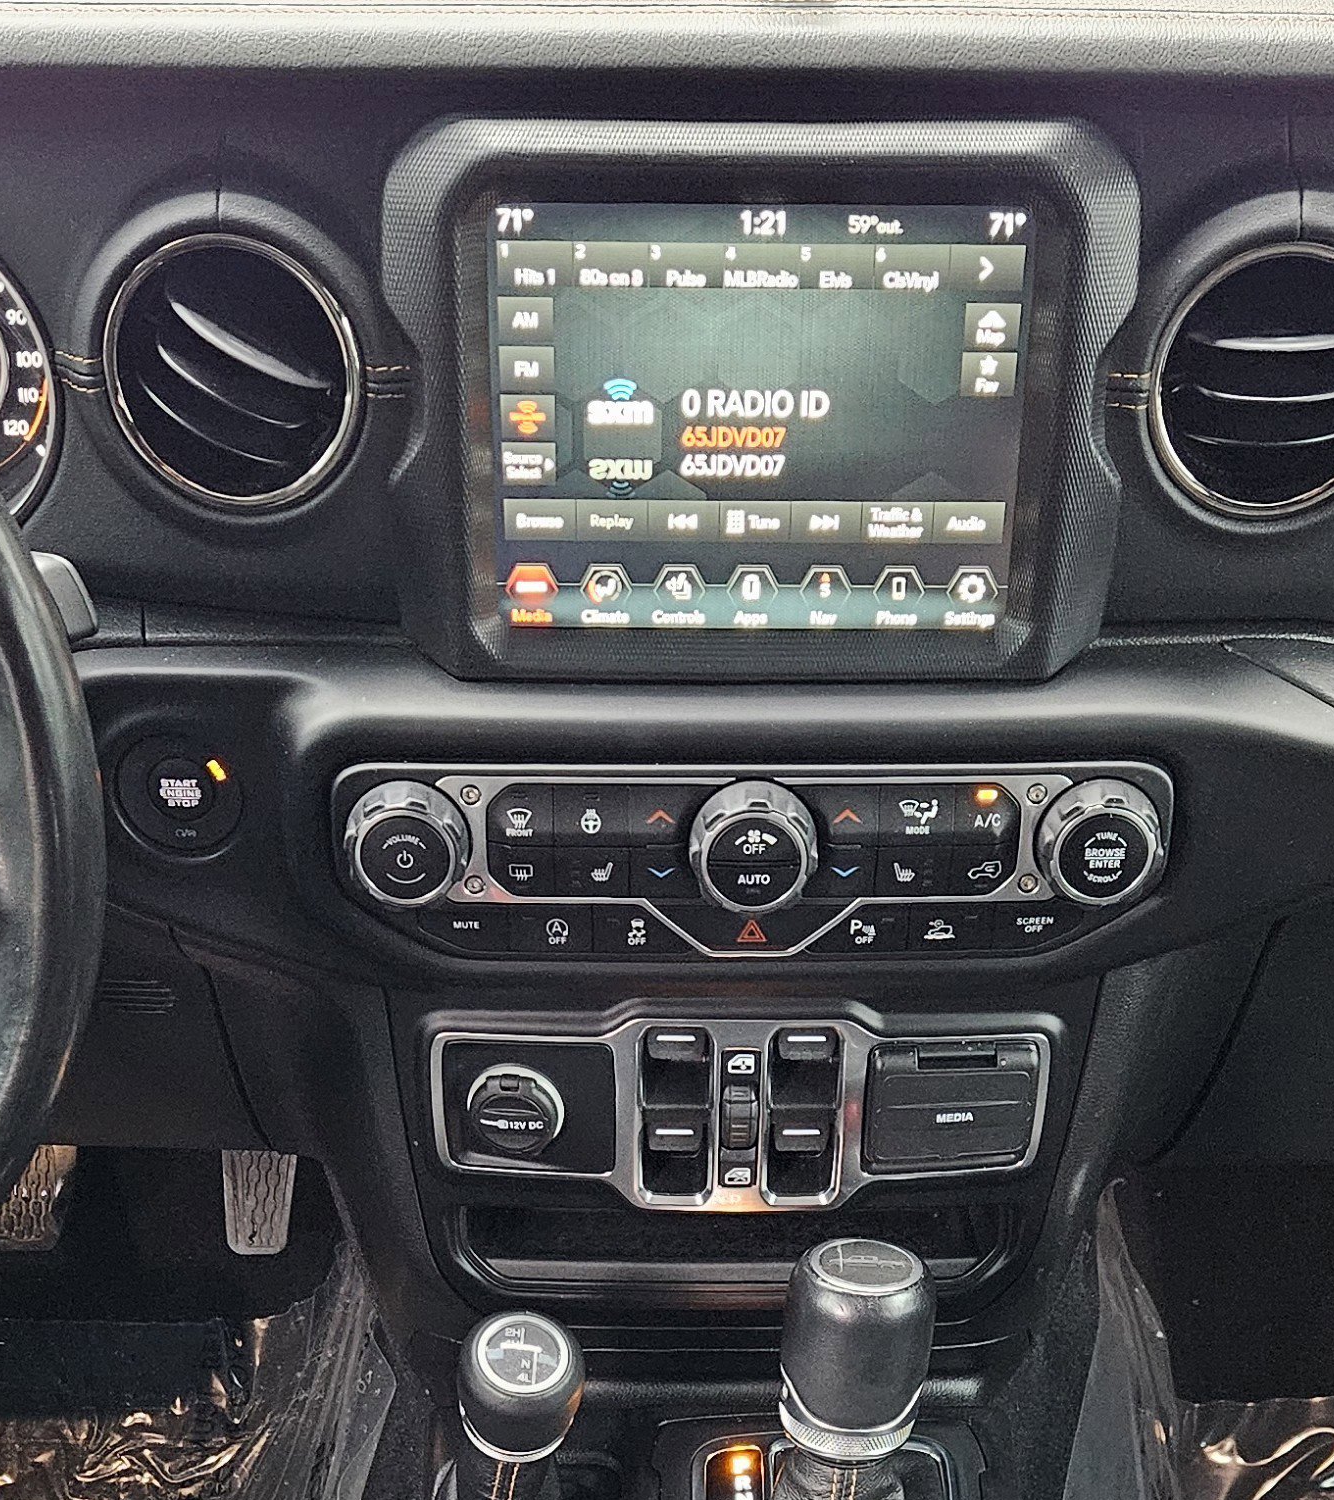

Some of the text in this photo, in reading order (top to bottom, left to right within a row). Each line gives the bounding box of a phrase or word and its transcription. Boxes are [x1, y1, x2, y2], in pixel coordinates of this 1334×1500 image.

[496, 208, 534, 233] 71°
[741, 210, 786, 236] 1:21
[990, 213, 1026, 236] 71°
[574, 244, 586, 260] 2
[650, 245, 661, 261] 3
[725, 246, 736, 261] 4
[801, 247, 811, 261] 5
[609, 273, 630, 287] on
[667, 269, 706, 287] Pulse
[5, 309, 27, 326] 90
[512, 312, 538, 329] AM
[16, 351, 43, 369] 100
[514, 361, 539, 377] FM
[17, 387, 39, 403] 110
[707, 389, 794, 418] RADIO
[800, 390, 830, 418] ID
[3, 420, 29, 436] 120
[681, 426, 786, 448] 65JDVD07
[680, 454, 785, 477] 65JDVD07
[516, 513, 564, 529] Browse
[590, 514, 633, 530] Replay
[748, 515, 780, 530] Tune
[946, 517, 986, 531] Audio
[511, 609, 553, 623] Media
[581, 610, 630, 624] Climate
[652, 610, 705, 625] Controls
[734, 611, 767, 626] Apps
[810, 611, 837, 625] Nav
[876, 611, 917, 625] Phone
[944, 611, 995, 628] Settings
[160, 778, 198, 787] START
[159, 788, 202, 798] ENGINE
[167, 799, 199, 807] STOP
[974, 813, 1002, 828] A/C
[505, 828, 534, 838] FRONT
[905, 826, 930, 835] MODE
[1096, 831, 1118, 842] TUNE
[386, 835, 421, 847] VOLUME
[743, 843, 766, 855] OFF
[1084, 847, 1126, 858] BROWSE
[1088, 859, 1121, 870] ENTER
[737, 874, 771, 885] AUTO
[1086, 873, 1120, 884] SCROLL
[453, 920, 480, 930] MUTE
[850, 920, 863, 936] P
[1016, 916, 1054, 928] SCREEN
[1024, 924, 1044, 934] OFF
[548, 935, 567, 945] OFF
[627, 936, 647, 946] OFF
[854, 935, 874, 945] OFF
[936, 1111, 974, 1124] MEDIA
[509, 1121, 544, 1130] 12V DC
[505, 1327, 521, 1338] 2H
[521, 1358, 531, 1370] N
[516, 1372, 531, 1383] 4L
[733, 1456, 751, 1475] P
[735, 1475, 752, 1491] R
